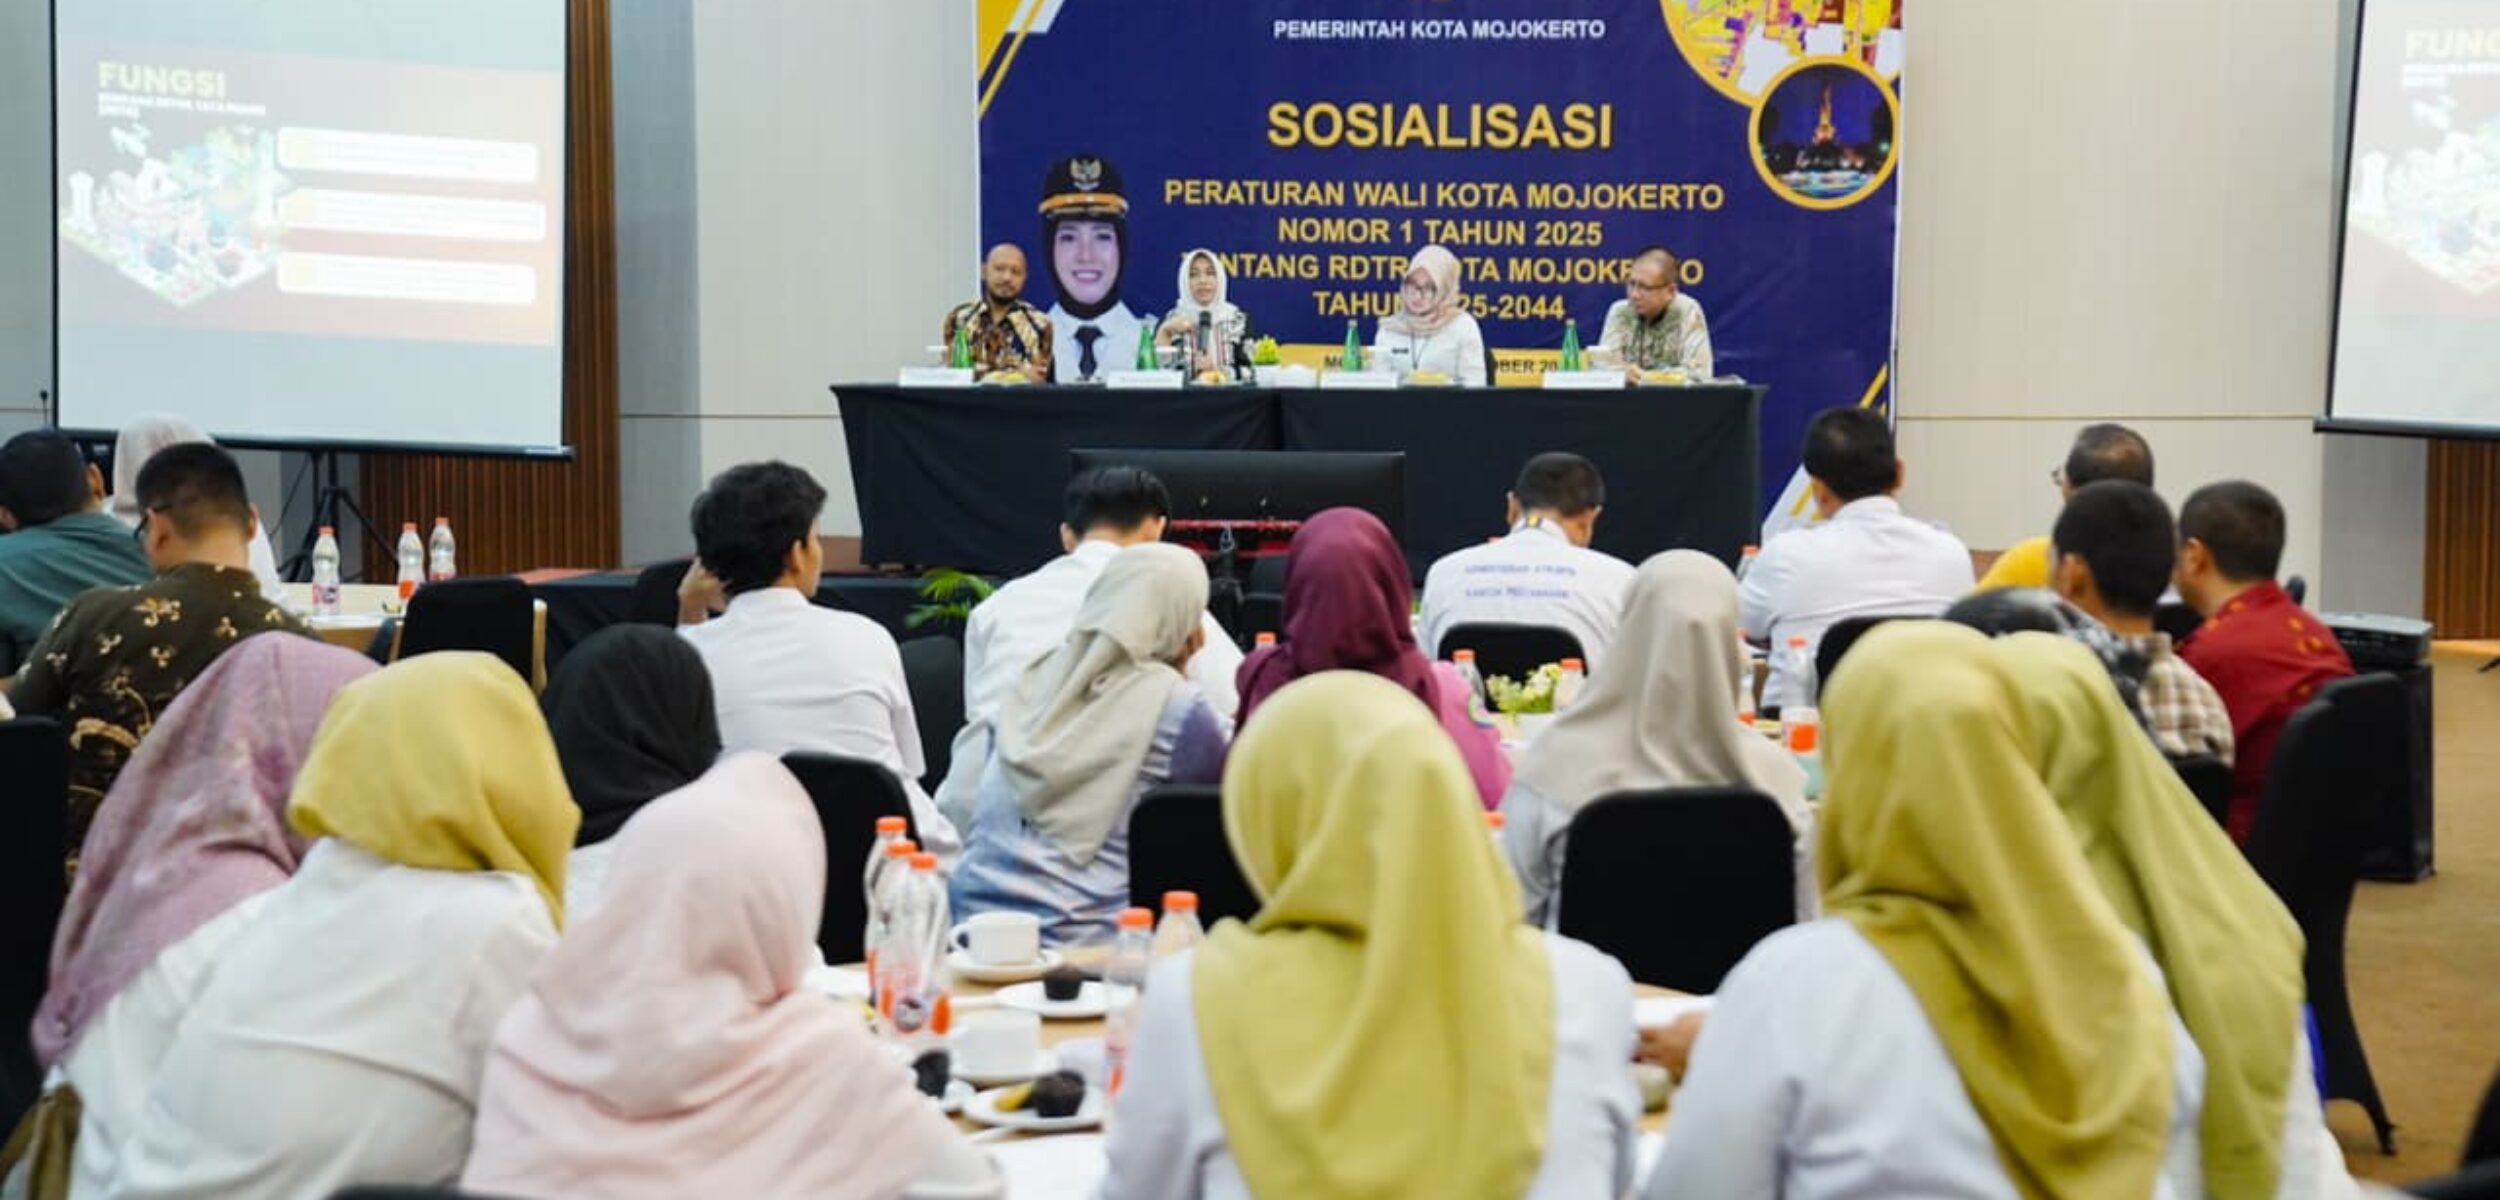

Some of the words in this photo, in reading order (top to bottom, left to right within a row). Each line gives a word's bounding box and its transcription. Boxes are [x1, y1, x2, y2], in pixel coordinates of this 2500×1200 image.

[1273, 19, 1406, 39] PEMERINTAH
[1410, 19, 1468, 39] KOTA
[1471, 19, 1606, 39] MOJOKERTO
[98, 60, 226, 97] FUNGSI
[1268, 102, 1612, 149] SOSIALISASI
[1164, 180, 1345, 205] PERATURAN
[1354, 183, 1428, 207] WALI
[1437, 183, 1519, 208] KOTA
[1527, 184, 1725, 211] MOJOKERTO
[1278, 218, 1390, 244] NOMOR
[1401, 220, 1413, 244] 1
[1424, 219, 1526, 246] TAHUN
[1535, 221, 1603, 247] 2025
[1180, 252, 1320, 280] NTANG
[1457, 293, 1566, 320] 25-2044
